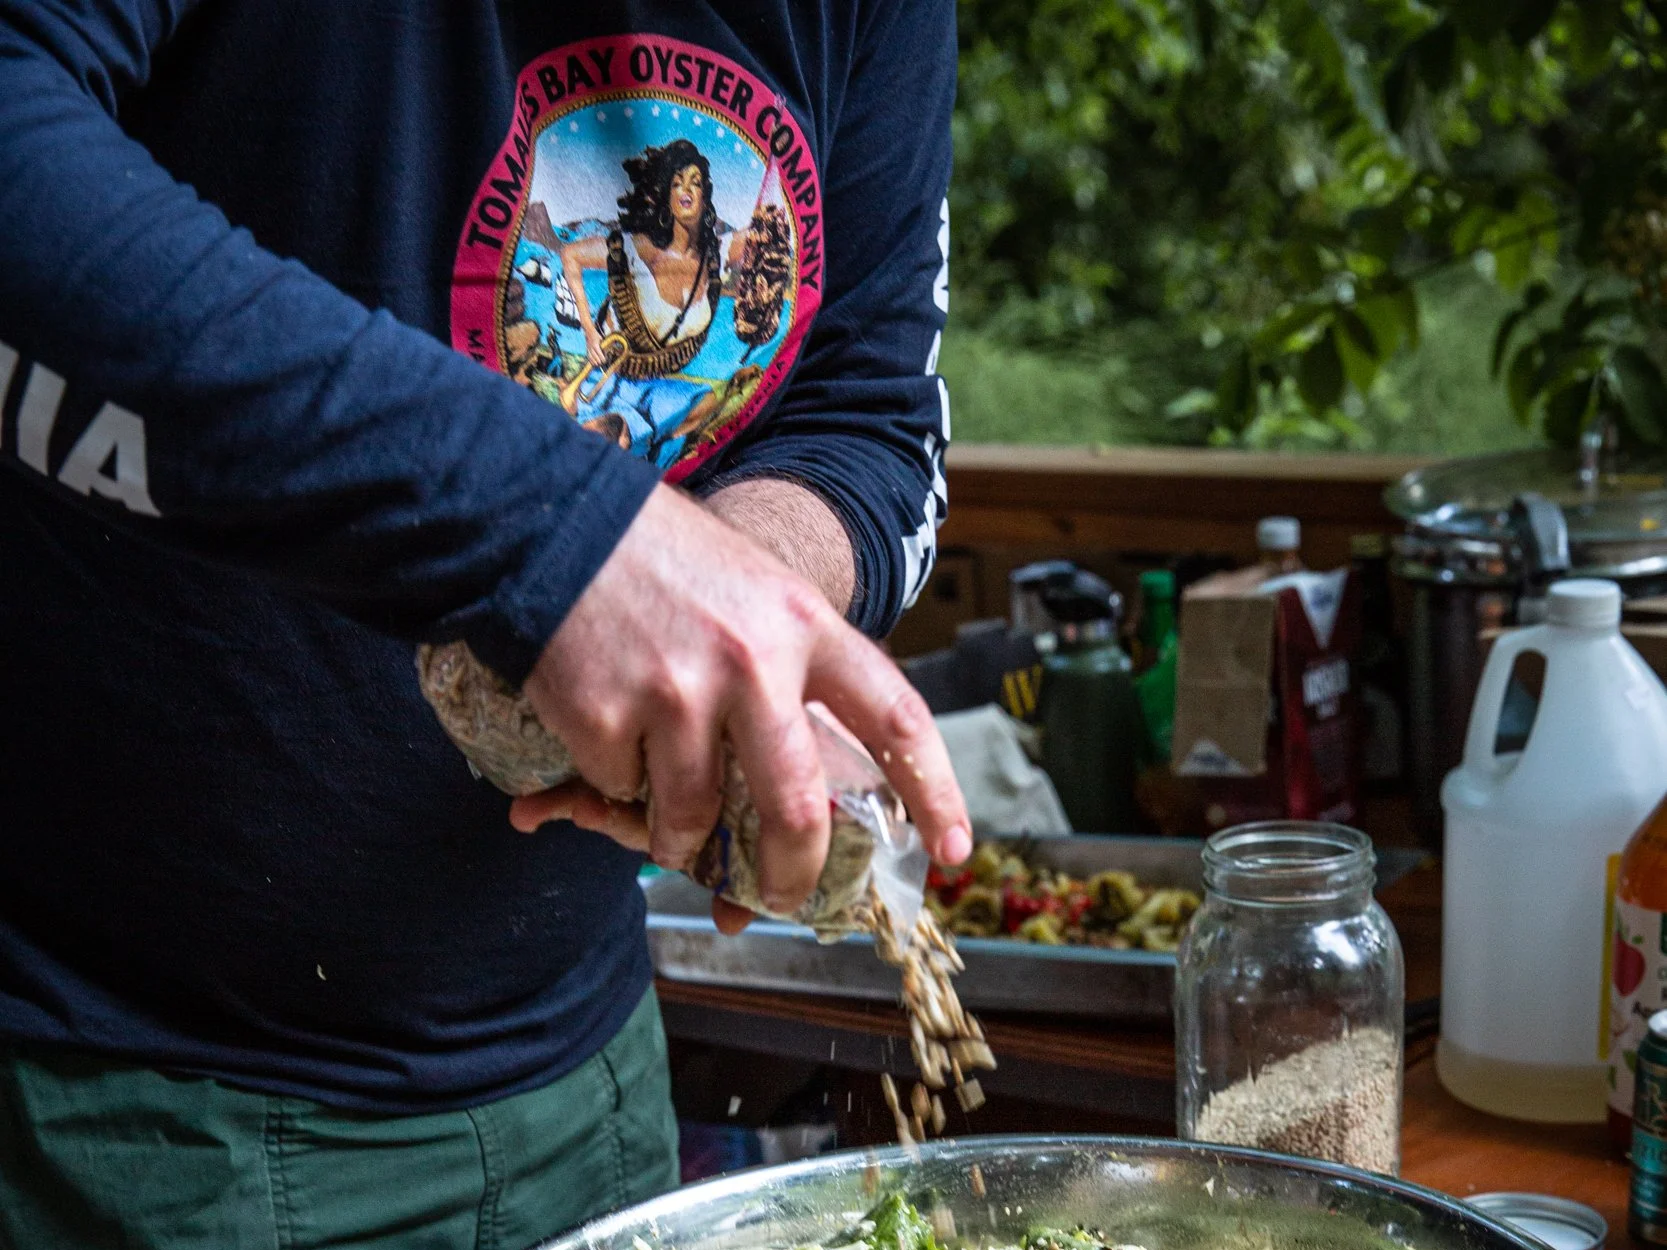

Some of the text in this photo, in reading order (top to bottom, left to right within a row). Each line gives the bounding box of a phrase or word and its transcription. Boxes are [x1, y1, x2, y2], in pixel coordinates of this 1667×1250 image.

[537, 47, 614, 103] BAY
[629, 45, 754, 121] OYSTER
[755, 106, 824, 290] COMPANY
